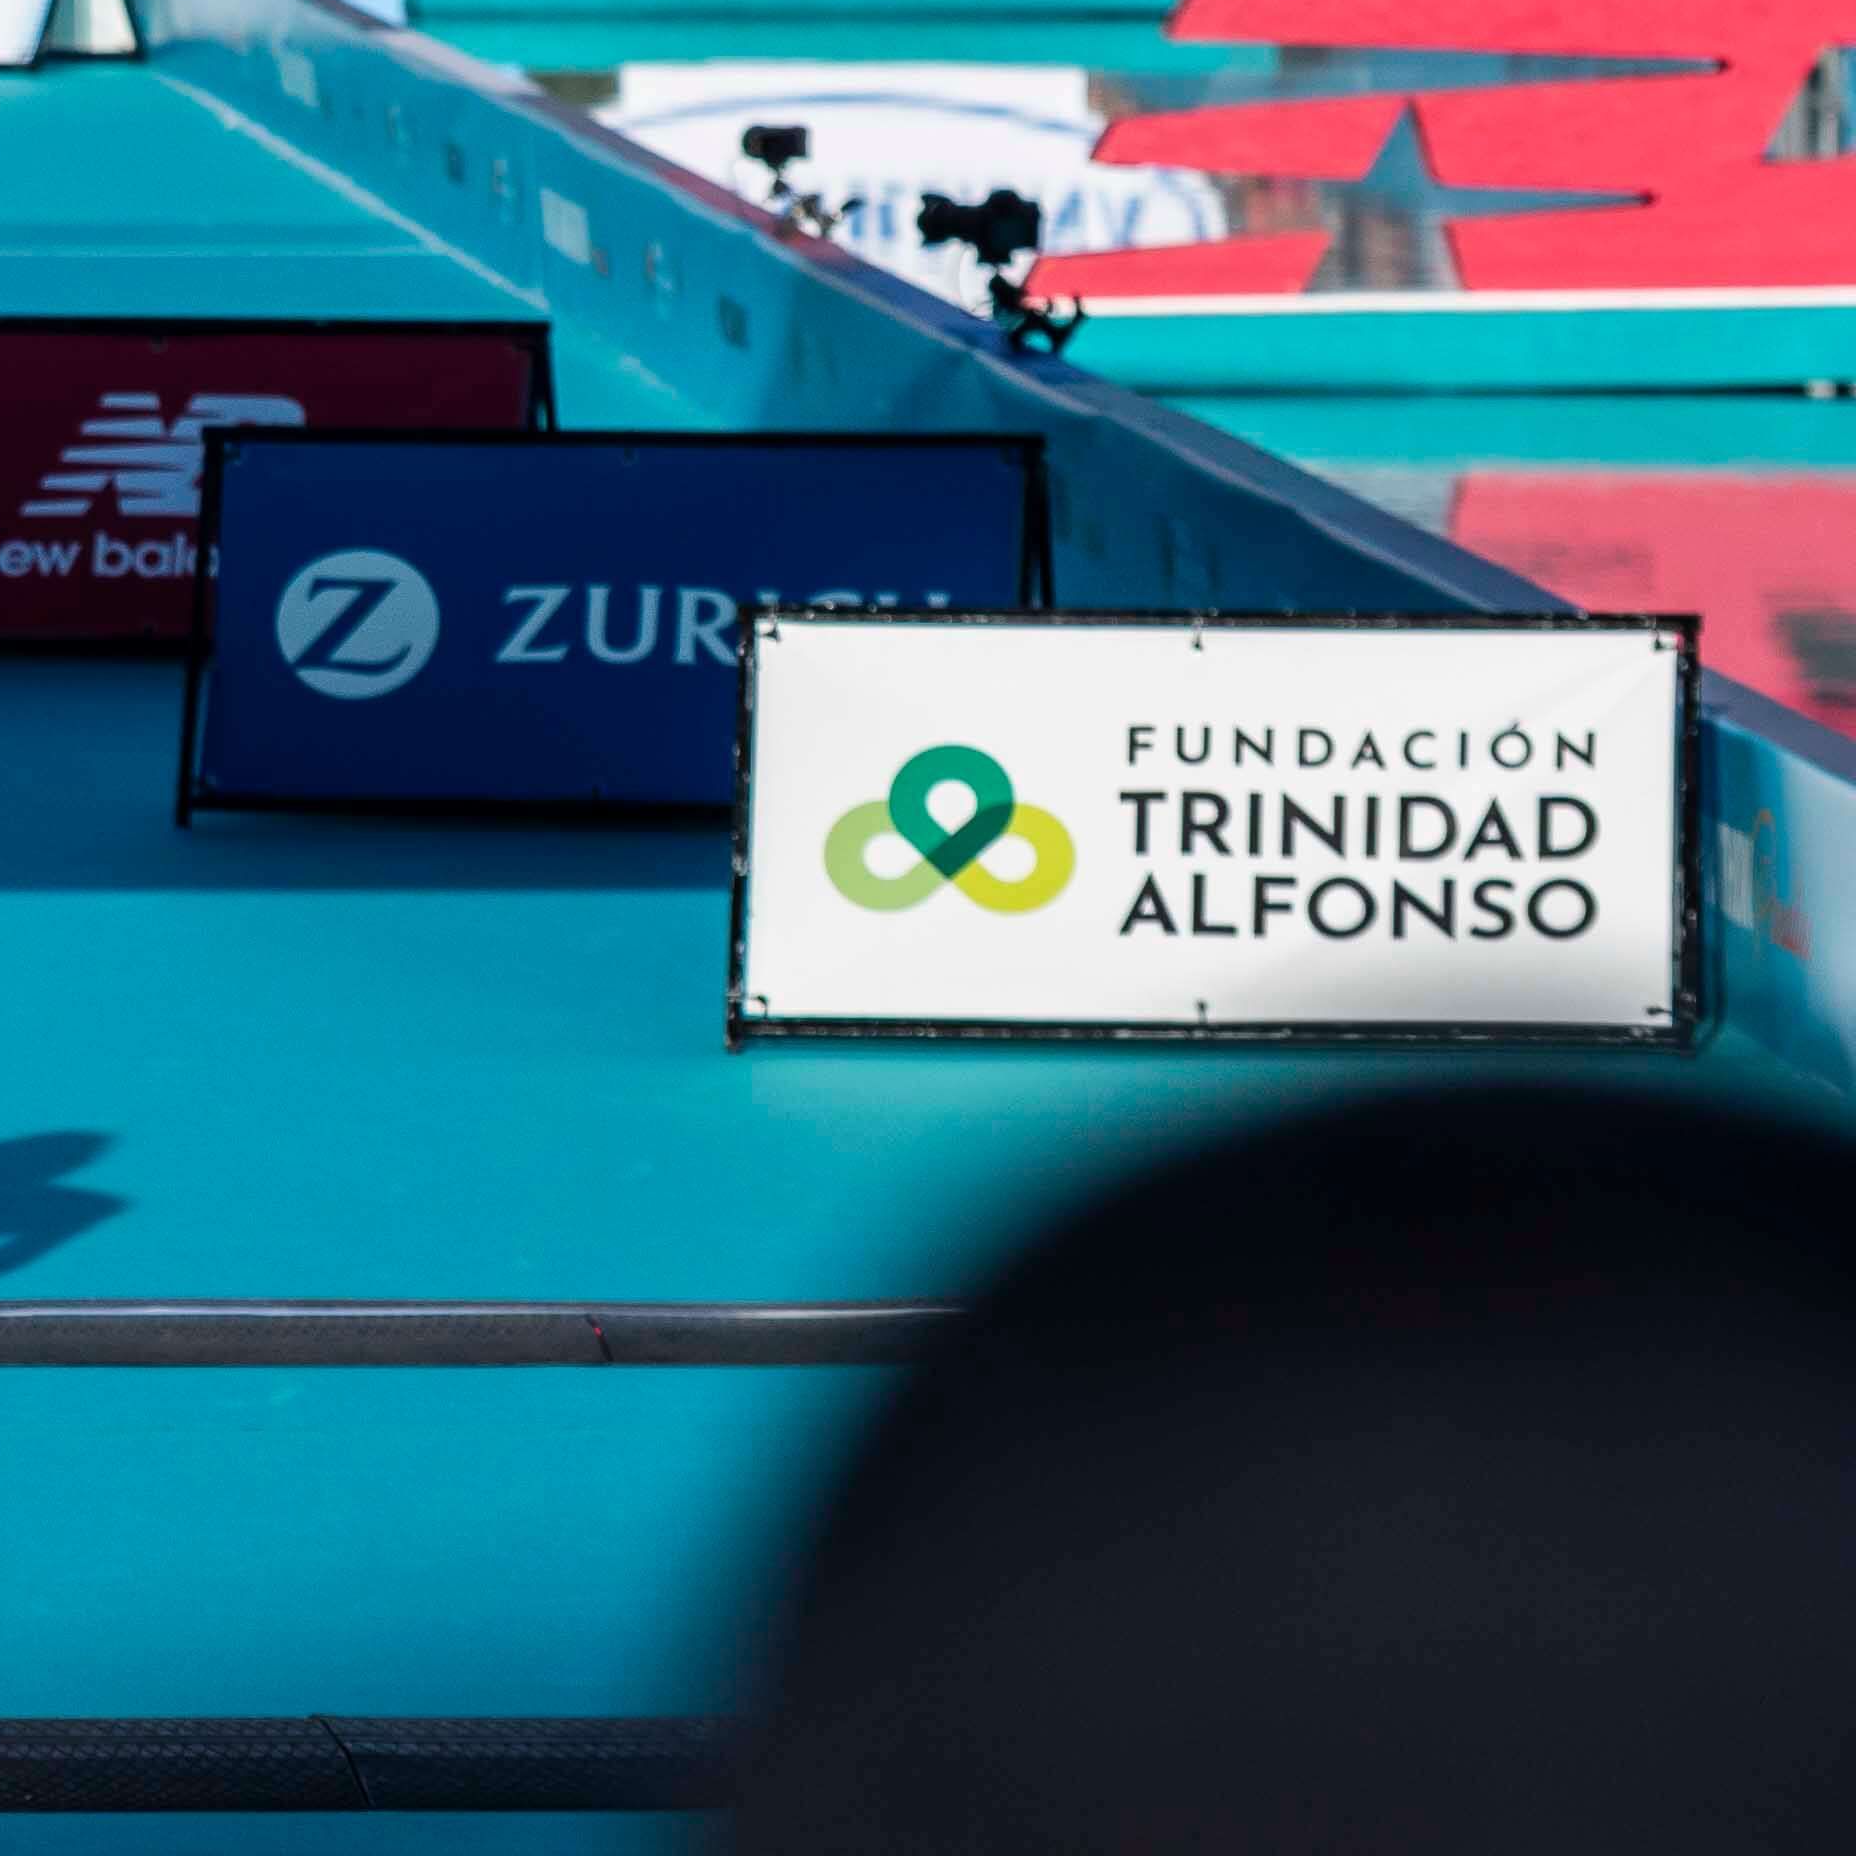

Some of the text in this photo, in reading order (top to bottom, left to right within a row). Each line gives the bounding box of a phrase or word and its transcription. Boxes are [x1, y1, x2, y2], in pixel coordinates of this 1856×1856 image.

[1126, 722, 1596, 771] FUNDACIÓN
[1119, 790, 1599, 864] TRINIDAD
[1119, 873, 1598, 940] ALFONSO
